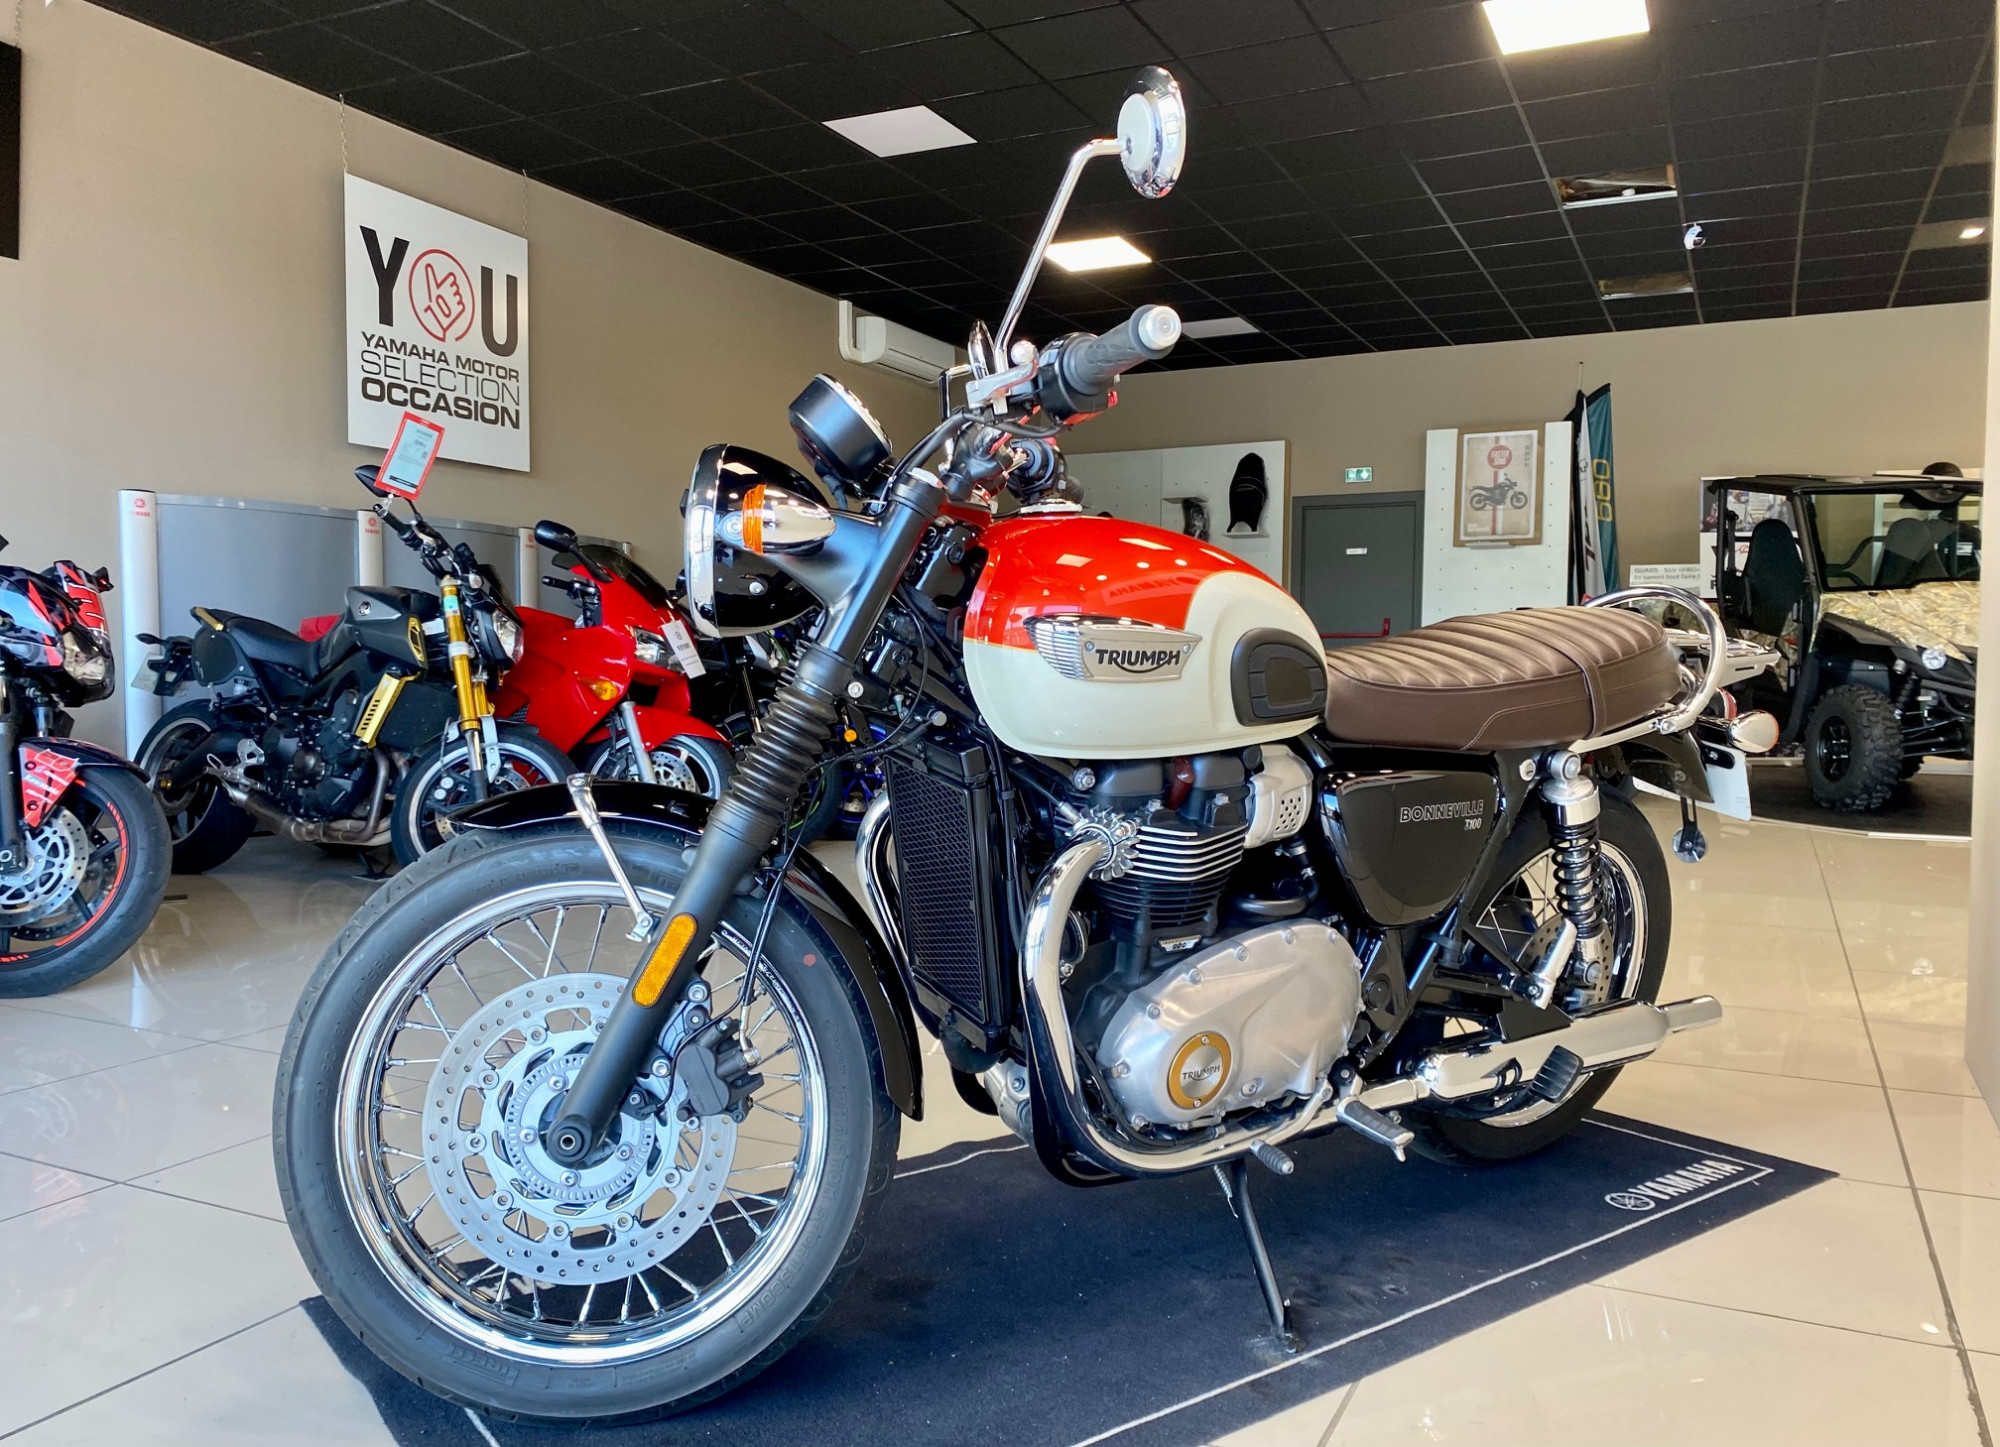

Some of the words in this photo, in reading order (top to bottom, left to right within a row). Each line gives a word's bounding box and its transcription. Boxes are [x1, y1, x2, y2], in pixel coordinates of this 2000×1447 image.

[361, 331, 450, 366] YAMAHA
[456, 355, 520, 383] MOTOR
[361, 350, 520, 406] SELECTION
[361, 377, 520, 430] OCCASION
[1096, 649, 1181, 673] TRIUMPH
[1400, 800, 1484, 822] BONNEVILLE
[1464, 818, 1482, 831] T100
[1182, 1064, 1221, 1081] TRIUMPH
[1627, 1160, 1745, 1200] YAMAHA
